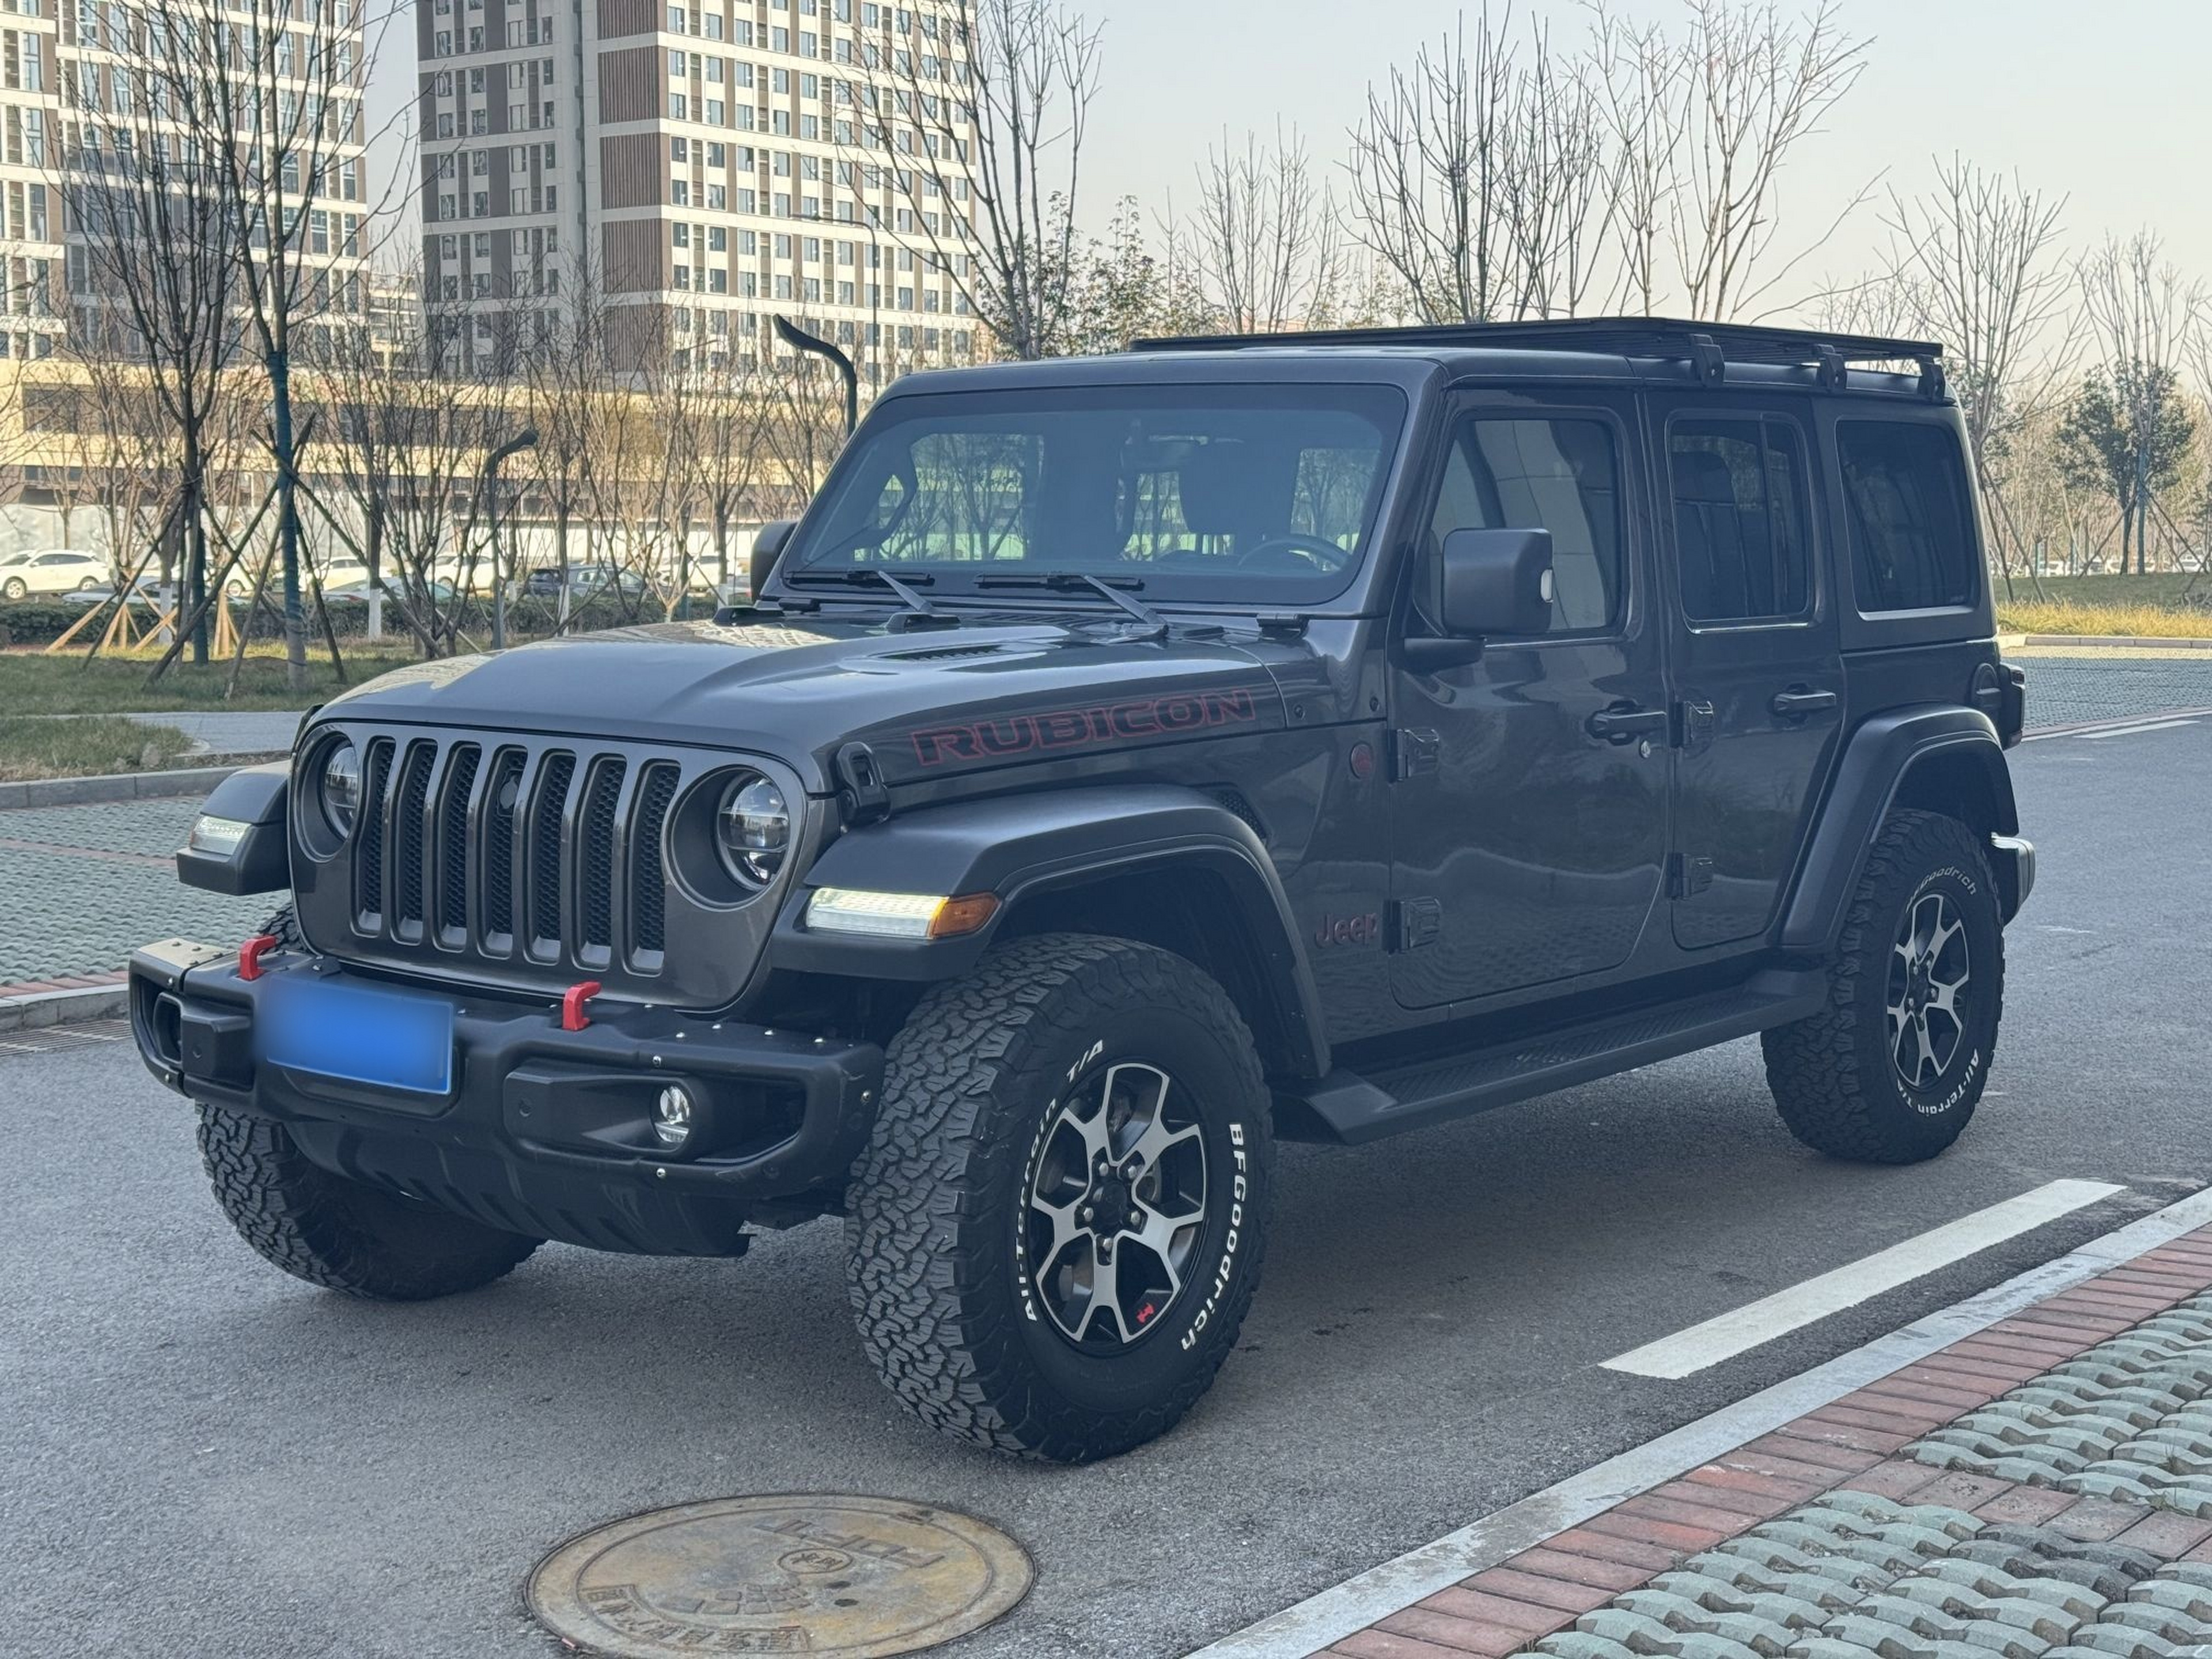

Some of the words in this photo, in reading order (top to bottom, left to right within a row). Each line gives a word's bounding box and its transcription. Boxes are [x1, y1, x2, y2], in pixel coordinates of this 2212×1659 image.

[910, 688, 1256, 766] RUBICON
[1315, 912, 1377, 948] Jeep
[1918, 1048, 1979, 1117] All-Terrain
[1015, 1097, 1056, 1321] All-Terrain
[1067, 1039, 1103, 1082] T/A
[1181, 1124, 1247, 1350] BFGoodrich
